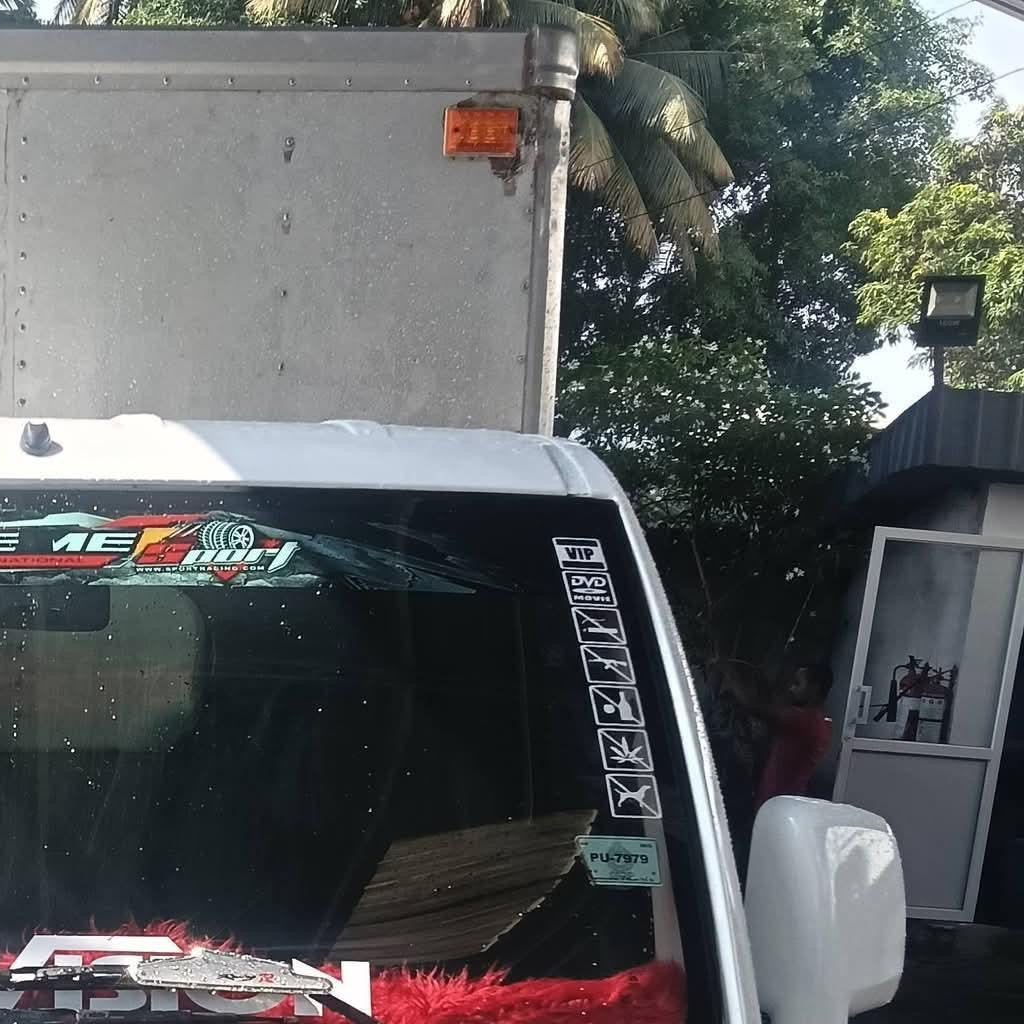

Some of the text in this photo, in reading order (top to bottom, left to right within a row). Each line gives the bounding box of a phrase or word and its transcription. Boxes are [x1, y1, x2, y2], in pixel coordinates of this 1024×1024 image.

[564, 547, 594, 561] VIP
[571, 575, 606, 588] DVD
[590, 852, 649, 864] PU-7979
